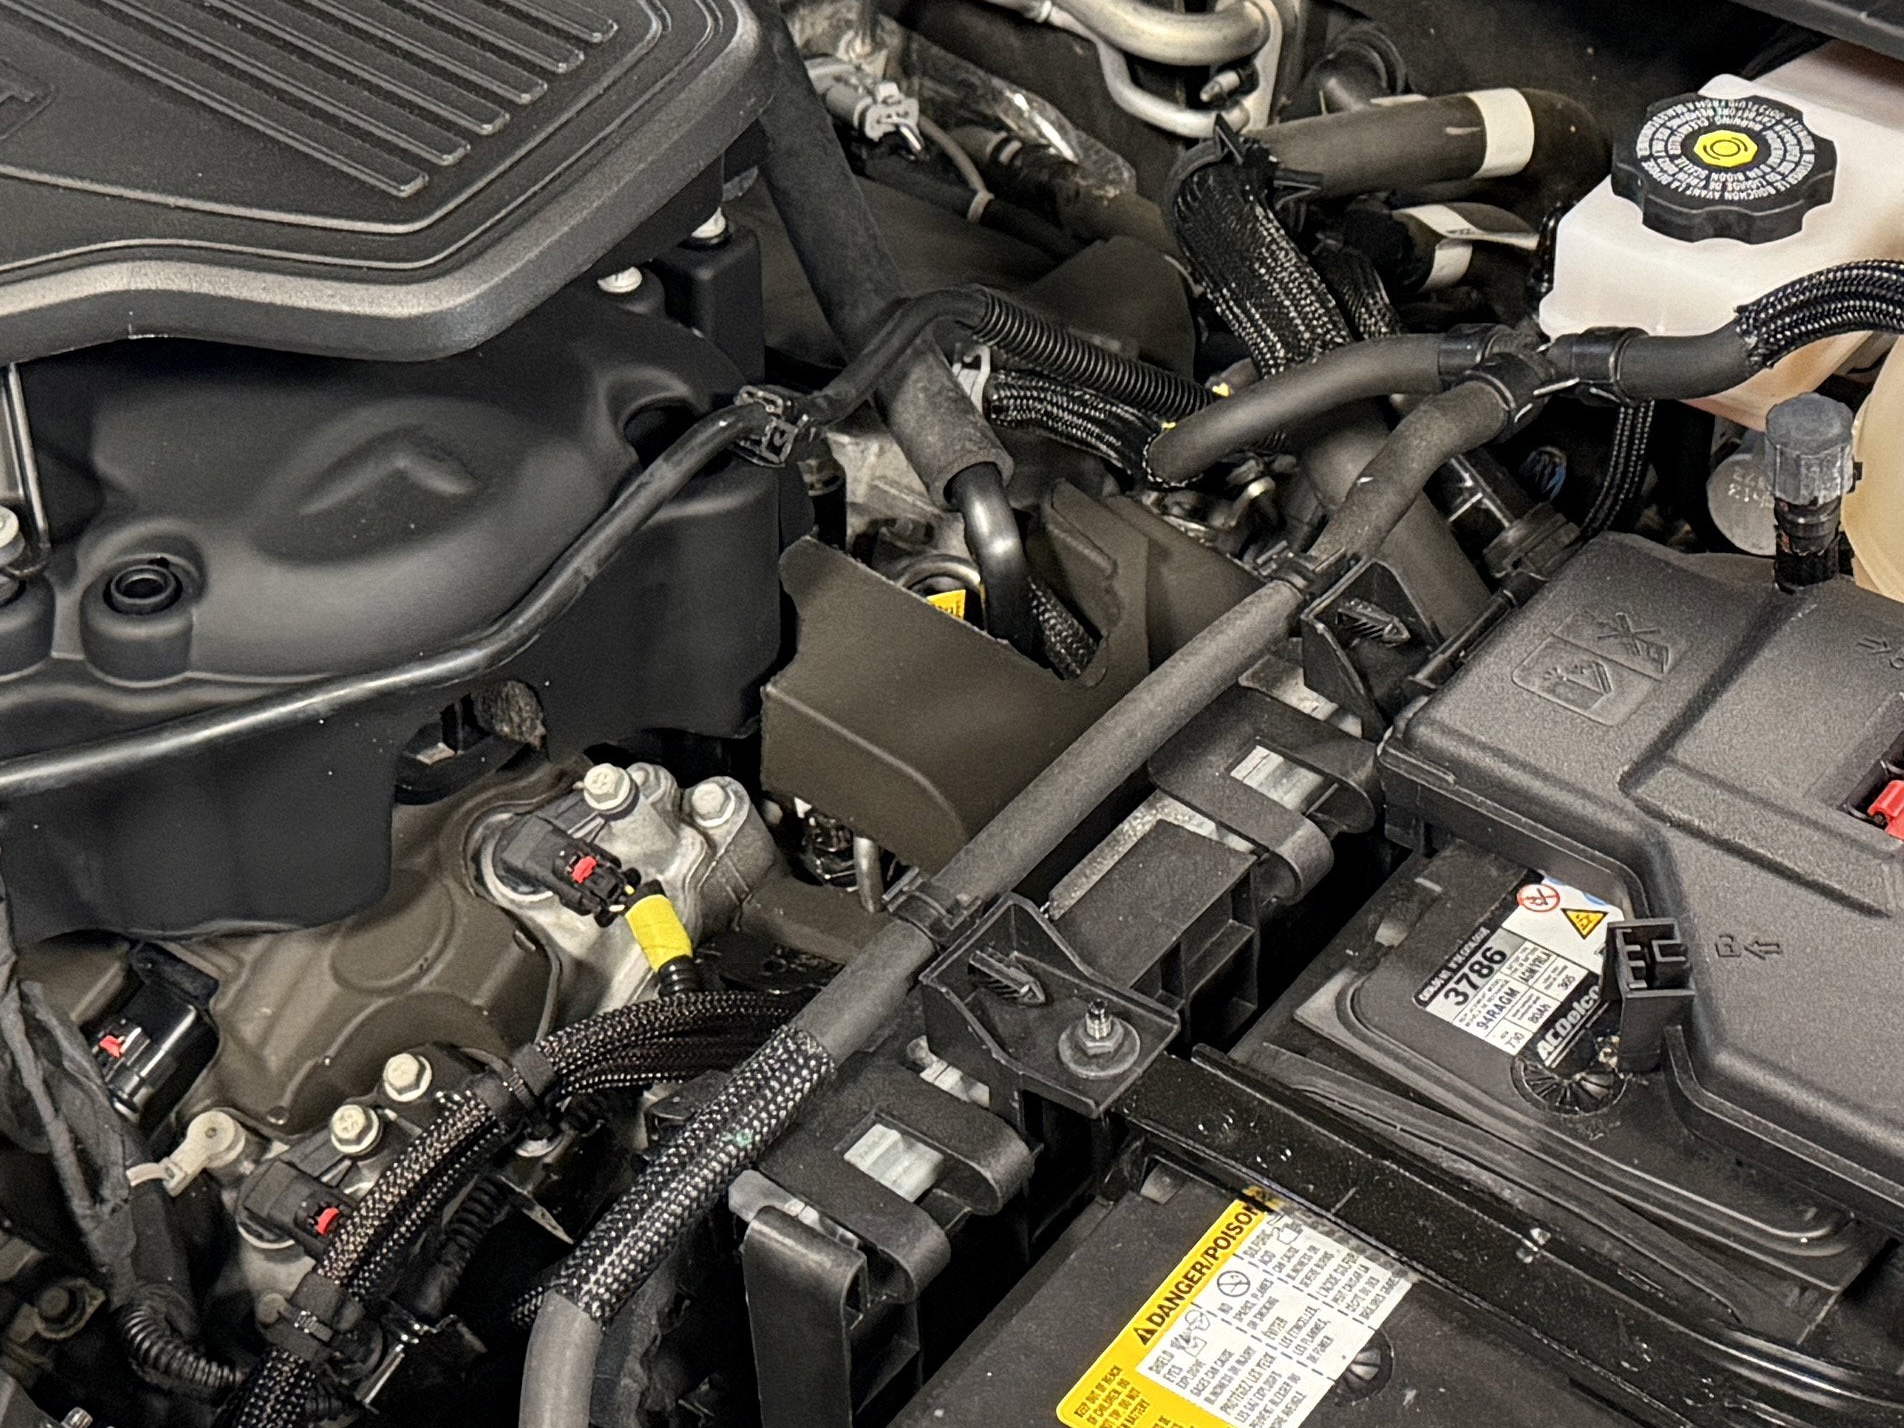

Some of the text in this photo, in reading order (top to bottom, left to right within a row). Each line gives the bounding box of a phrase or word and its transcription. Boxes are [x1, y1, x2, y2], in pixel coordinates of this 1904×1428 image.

[1685, 186, 1721, 199] AVANT
[1723, 184, 1775, 200] BOUCHON
[1442, 942, 1509, 1008] 3786
[1475, 985, 1521, 1032] 94RAGM
[1536, 985, 1602, 1055] ACDelco
